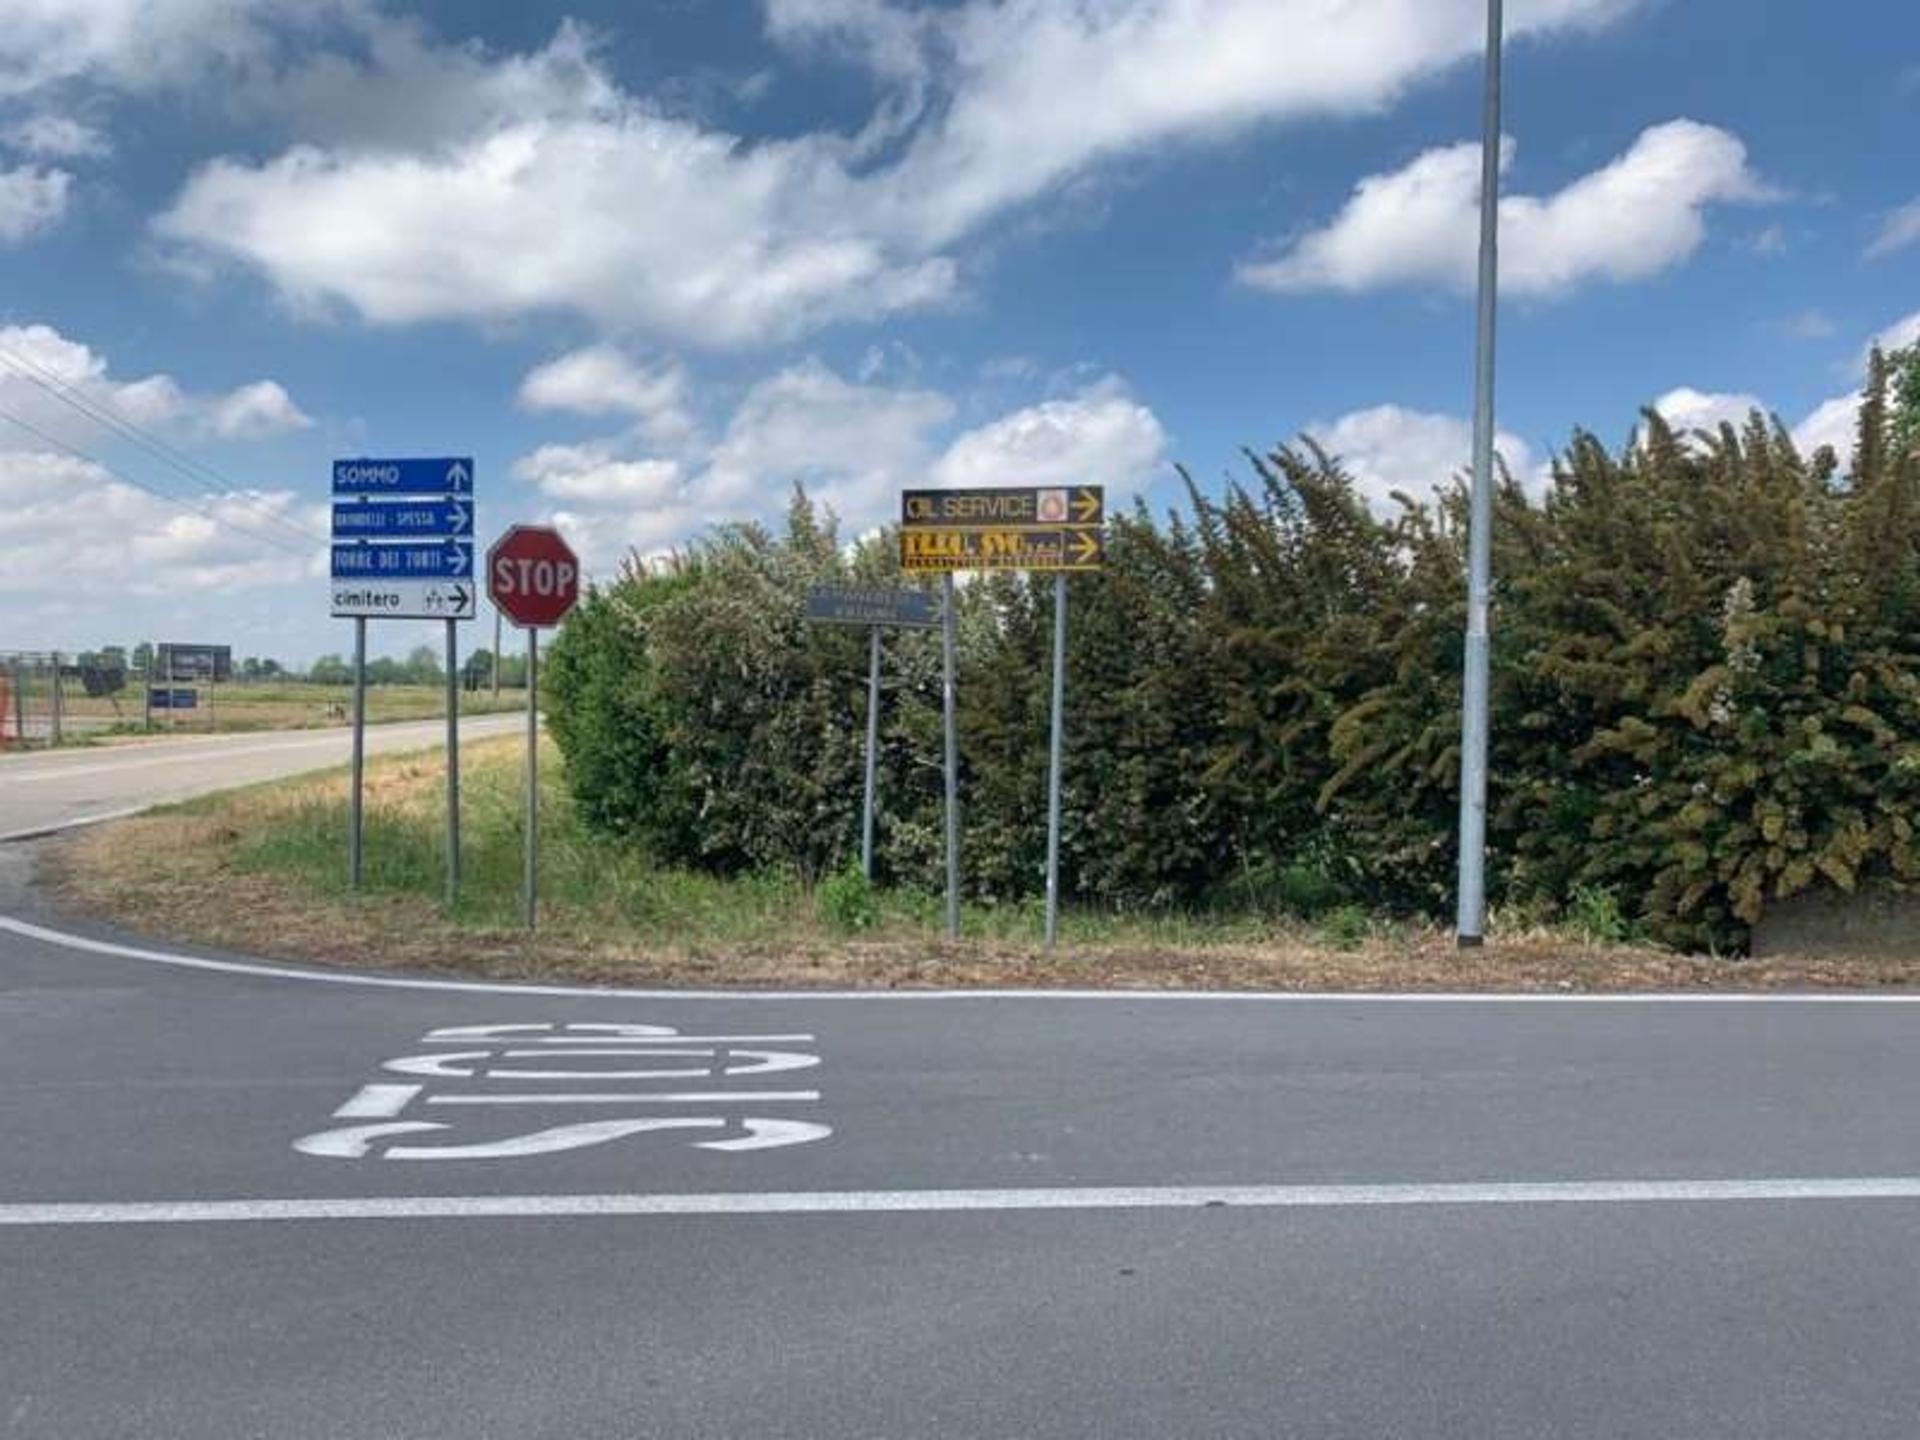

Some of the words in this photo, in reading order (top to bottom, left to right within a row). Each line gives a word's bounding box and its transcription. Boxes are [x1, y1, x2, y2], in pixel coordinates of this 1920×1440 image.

[336, 465, 400, 484] SOMMO
[943, 496, 1034, 517] SERVICE
[495, 558, 574, 597] STOP
[334, 590, 400, 607] cimitero
[291, 1022, 834, 1160] STOP
